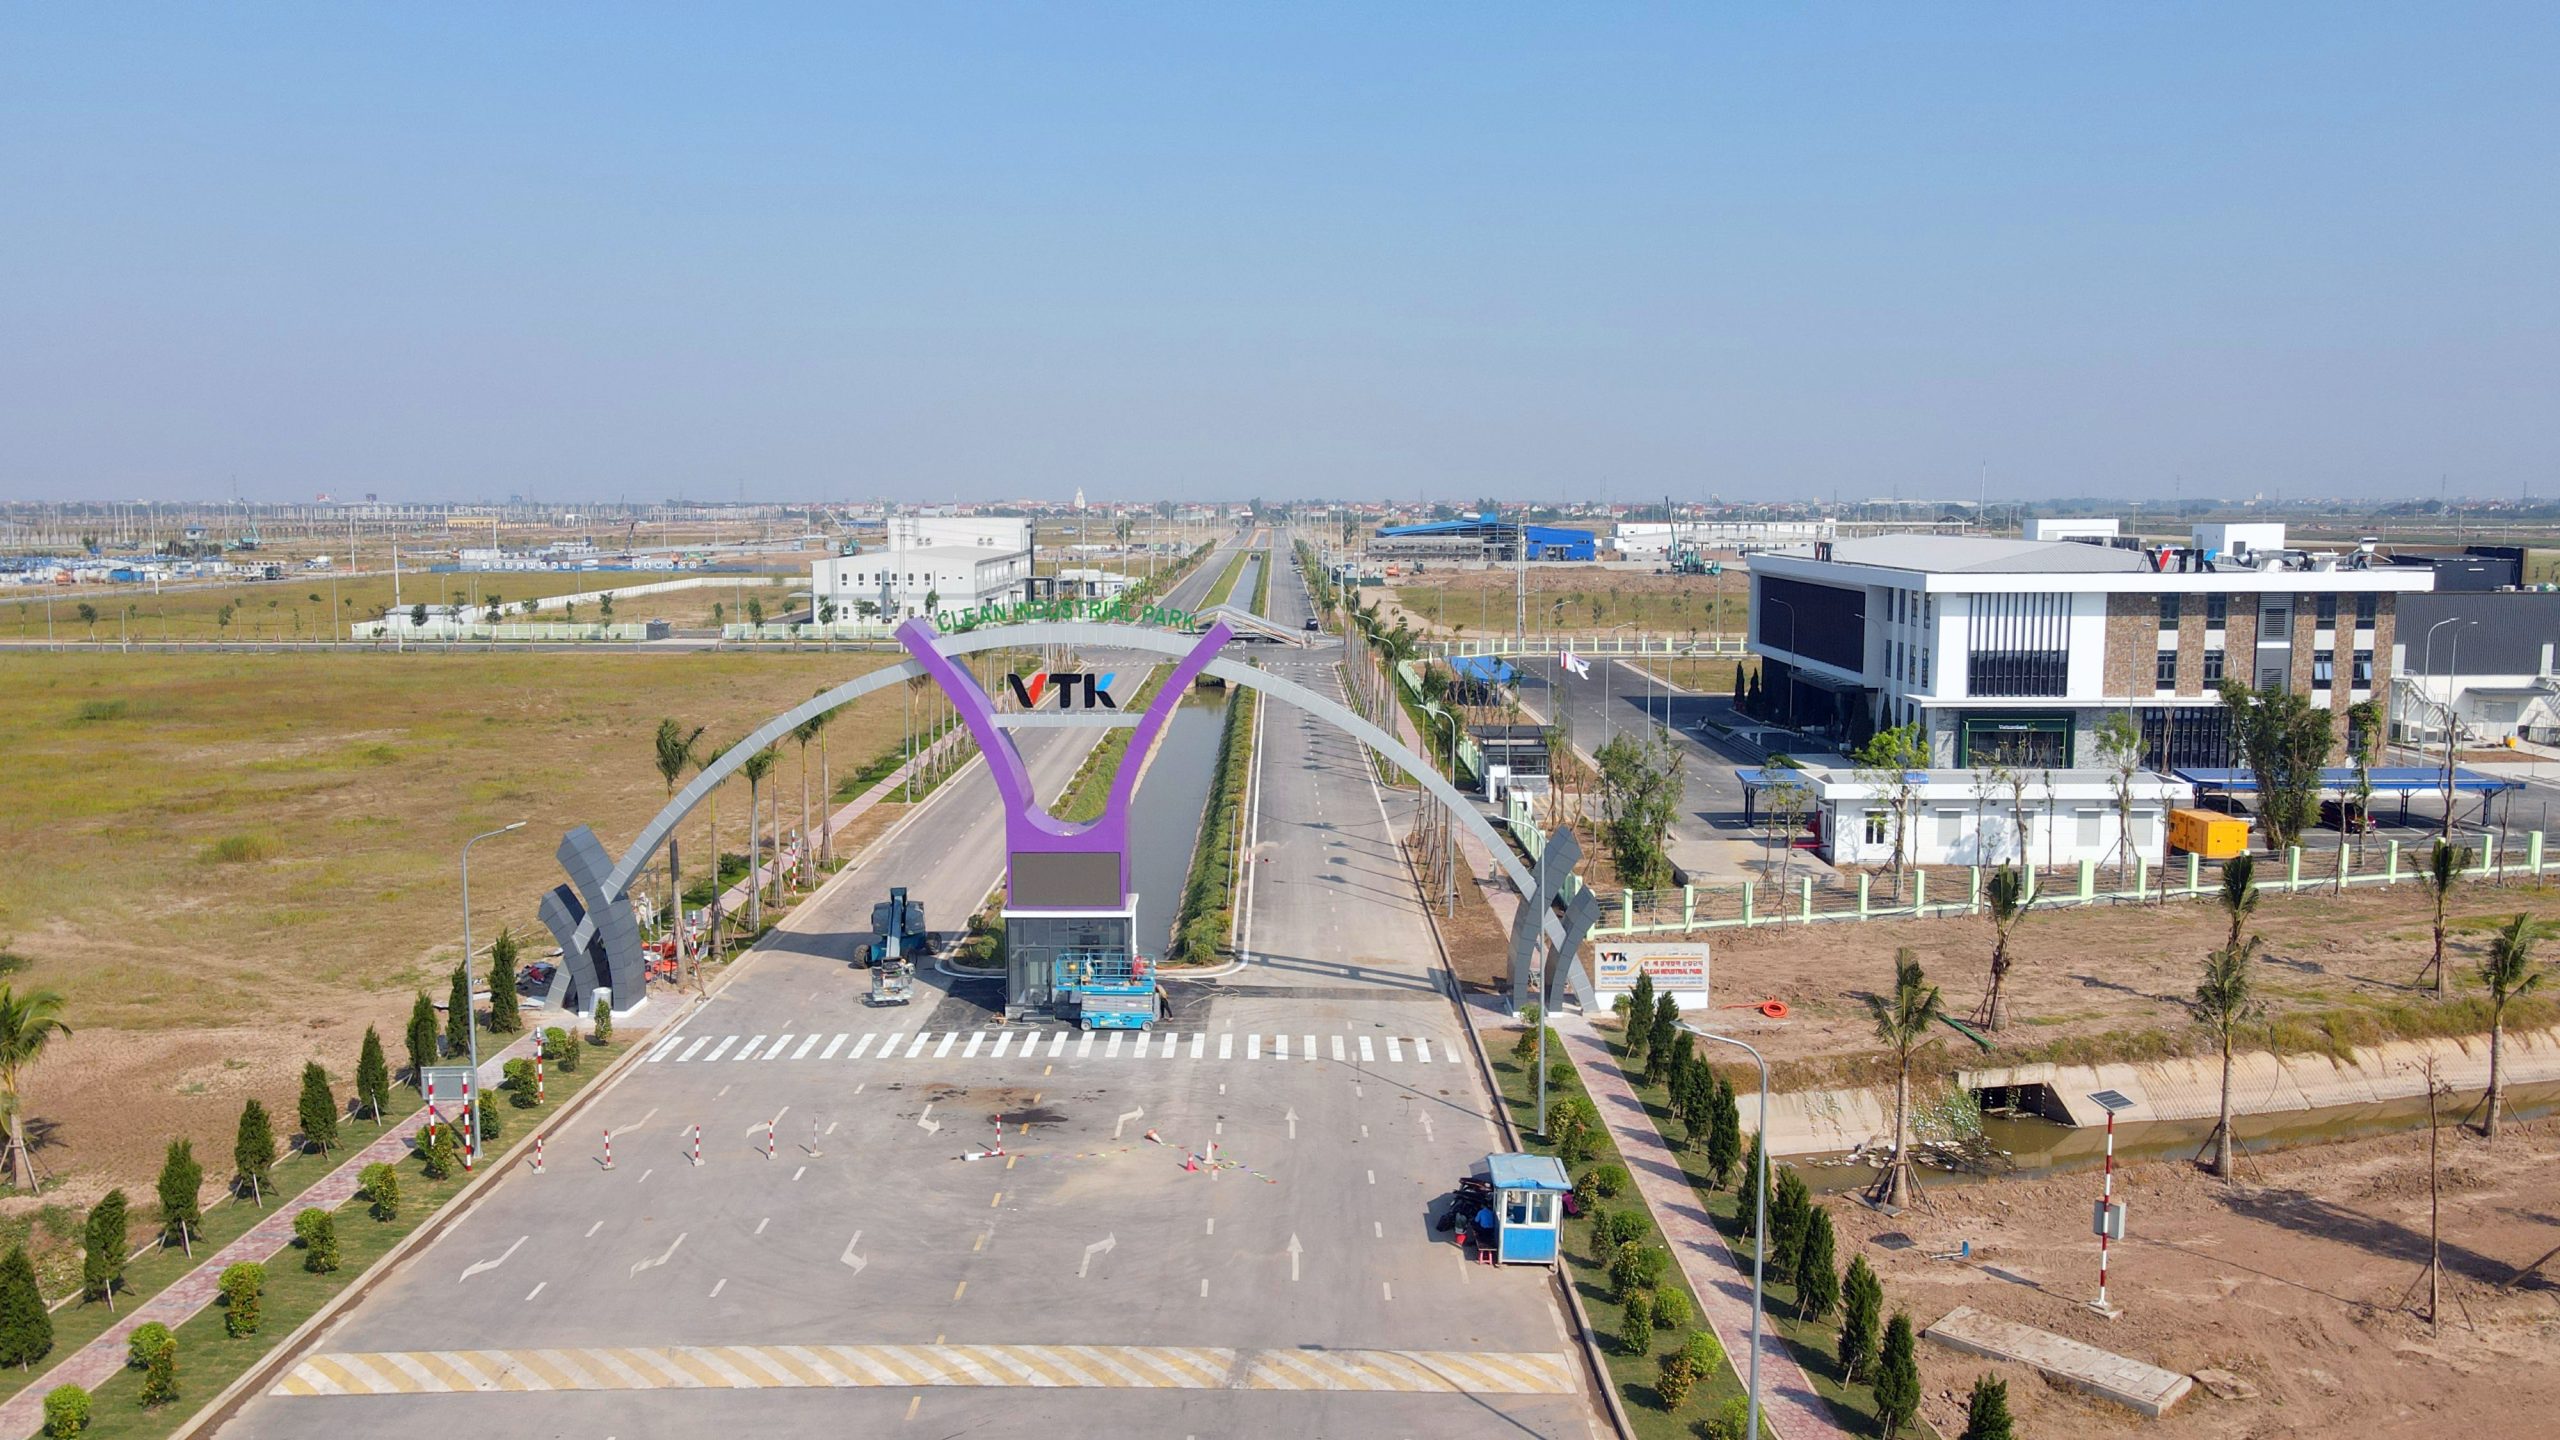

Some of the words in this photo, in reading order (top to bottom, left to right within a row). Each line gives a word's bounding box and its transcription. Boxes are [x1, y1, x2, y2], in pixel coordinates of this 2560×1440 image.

[2145, 548, 2218, 573] VTK
[936, 607, 1007, 632] CLEAN
[1012, 600, 1136, 623] INDUSTRIAL
[1141, 605, 1197, 633] PARK
[1008, 672, 1117, 709] VTK
[1600, 952, 1627, 962] VTK
